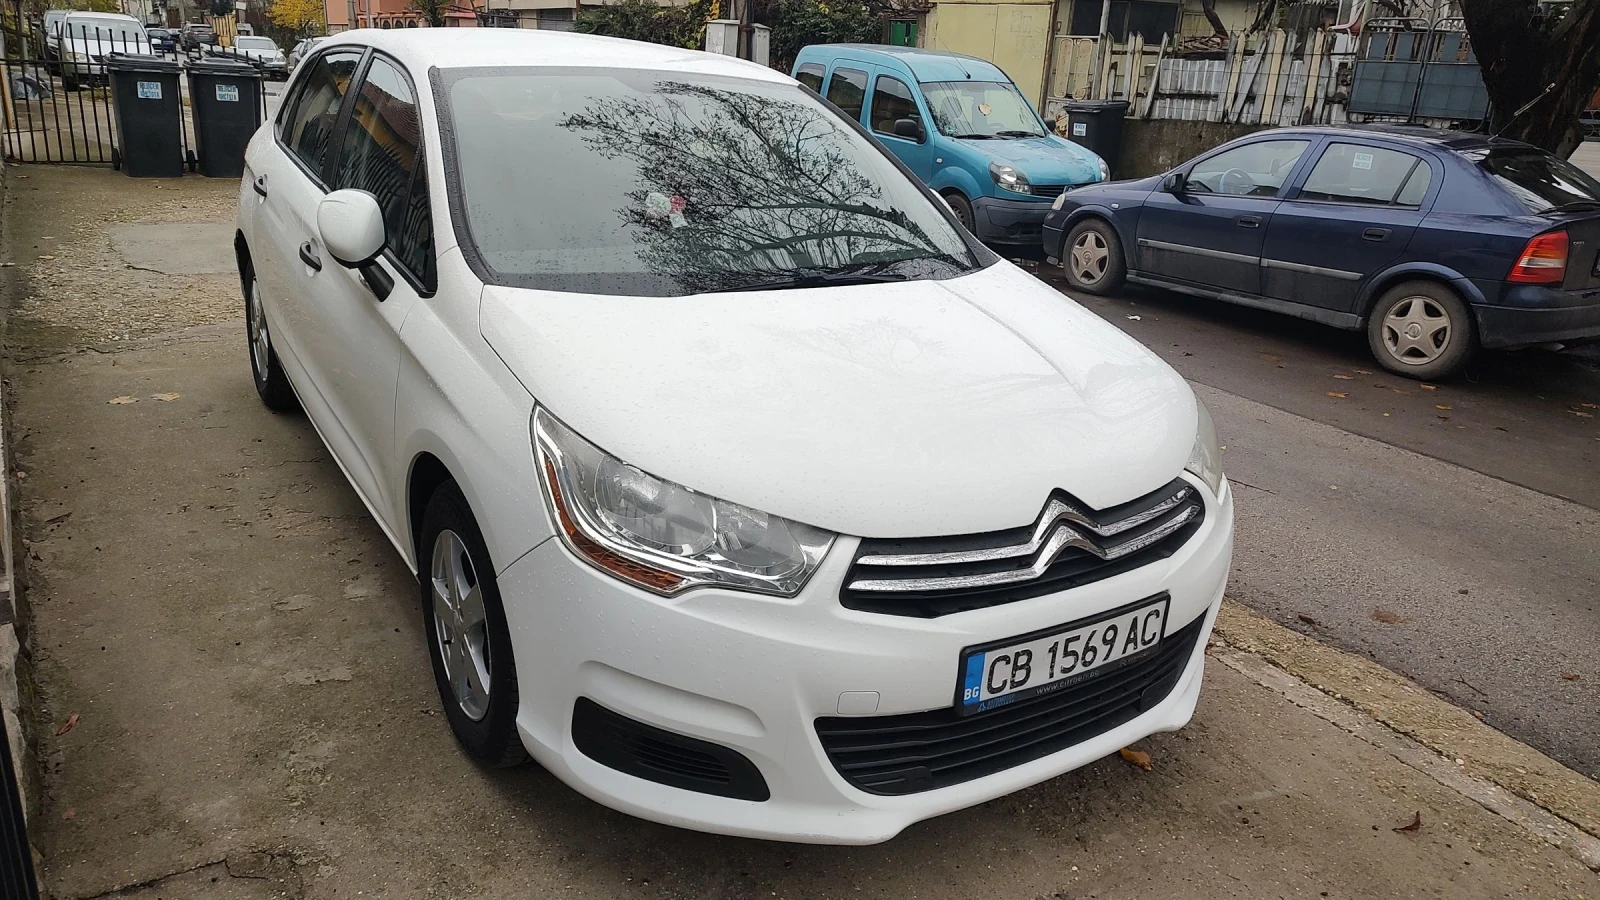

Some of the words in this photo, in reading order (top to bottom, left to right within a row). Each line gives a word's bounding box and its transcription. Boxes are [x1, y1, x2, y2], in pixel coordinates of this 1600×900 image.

[987, 649, 1033, 694] CB
[1048, 624, 1118, 679] 1569
[1121, 609, 1160, 655] AC
[964, 686, 979, 700] BG
